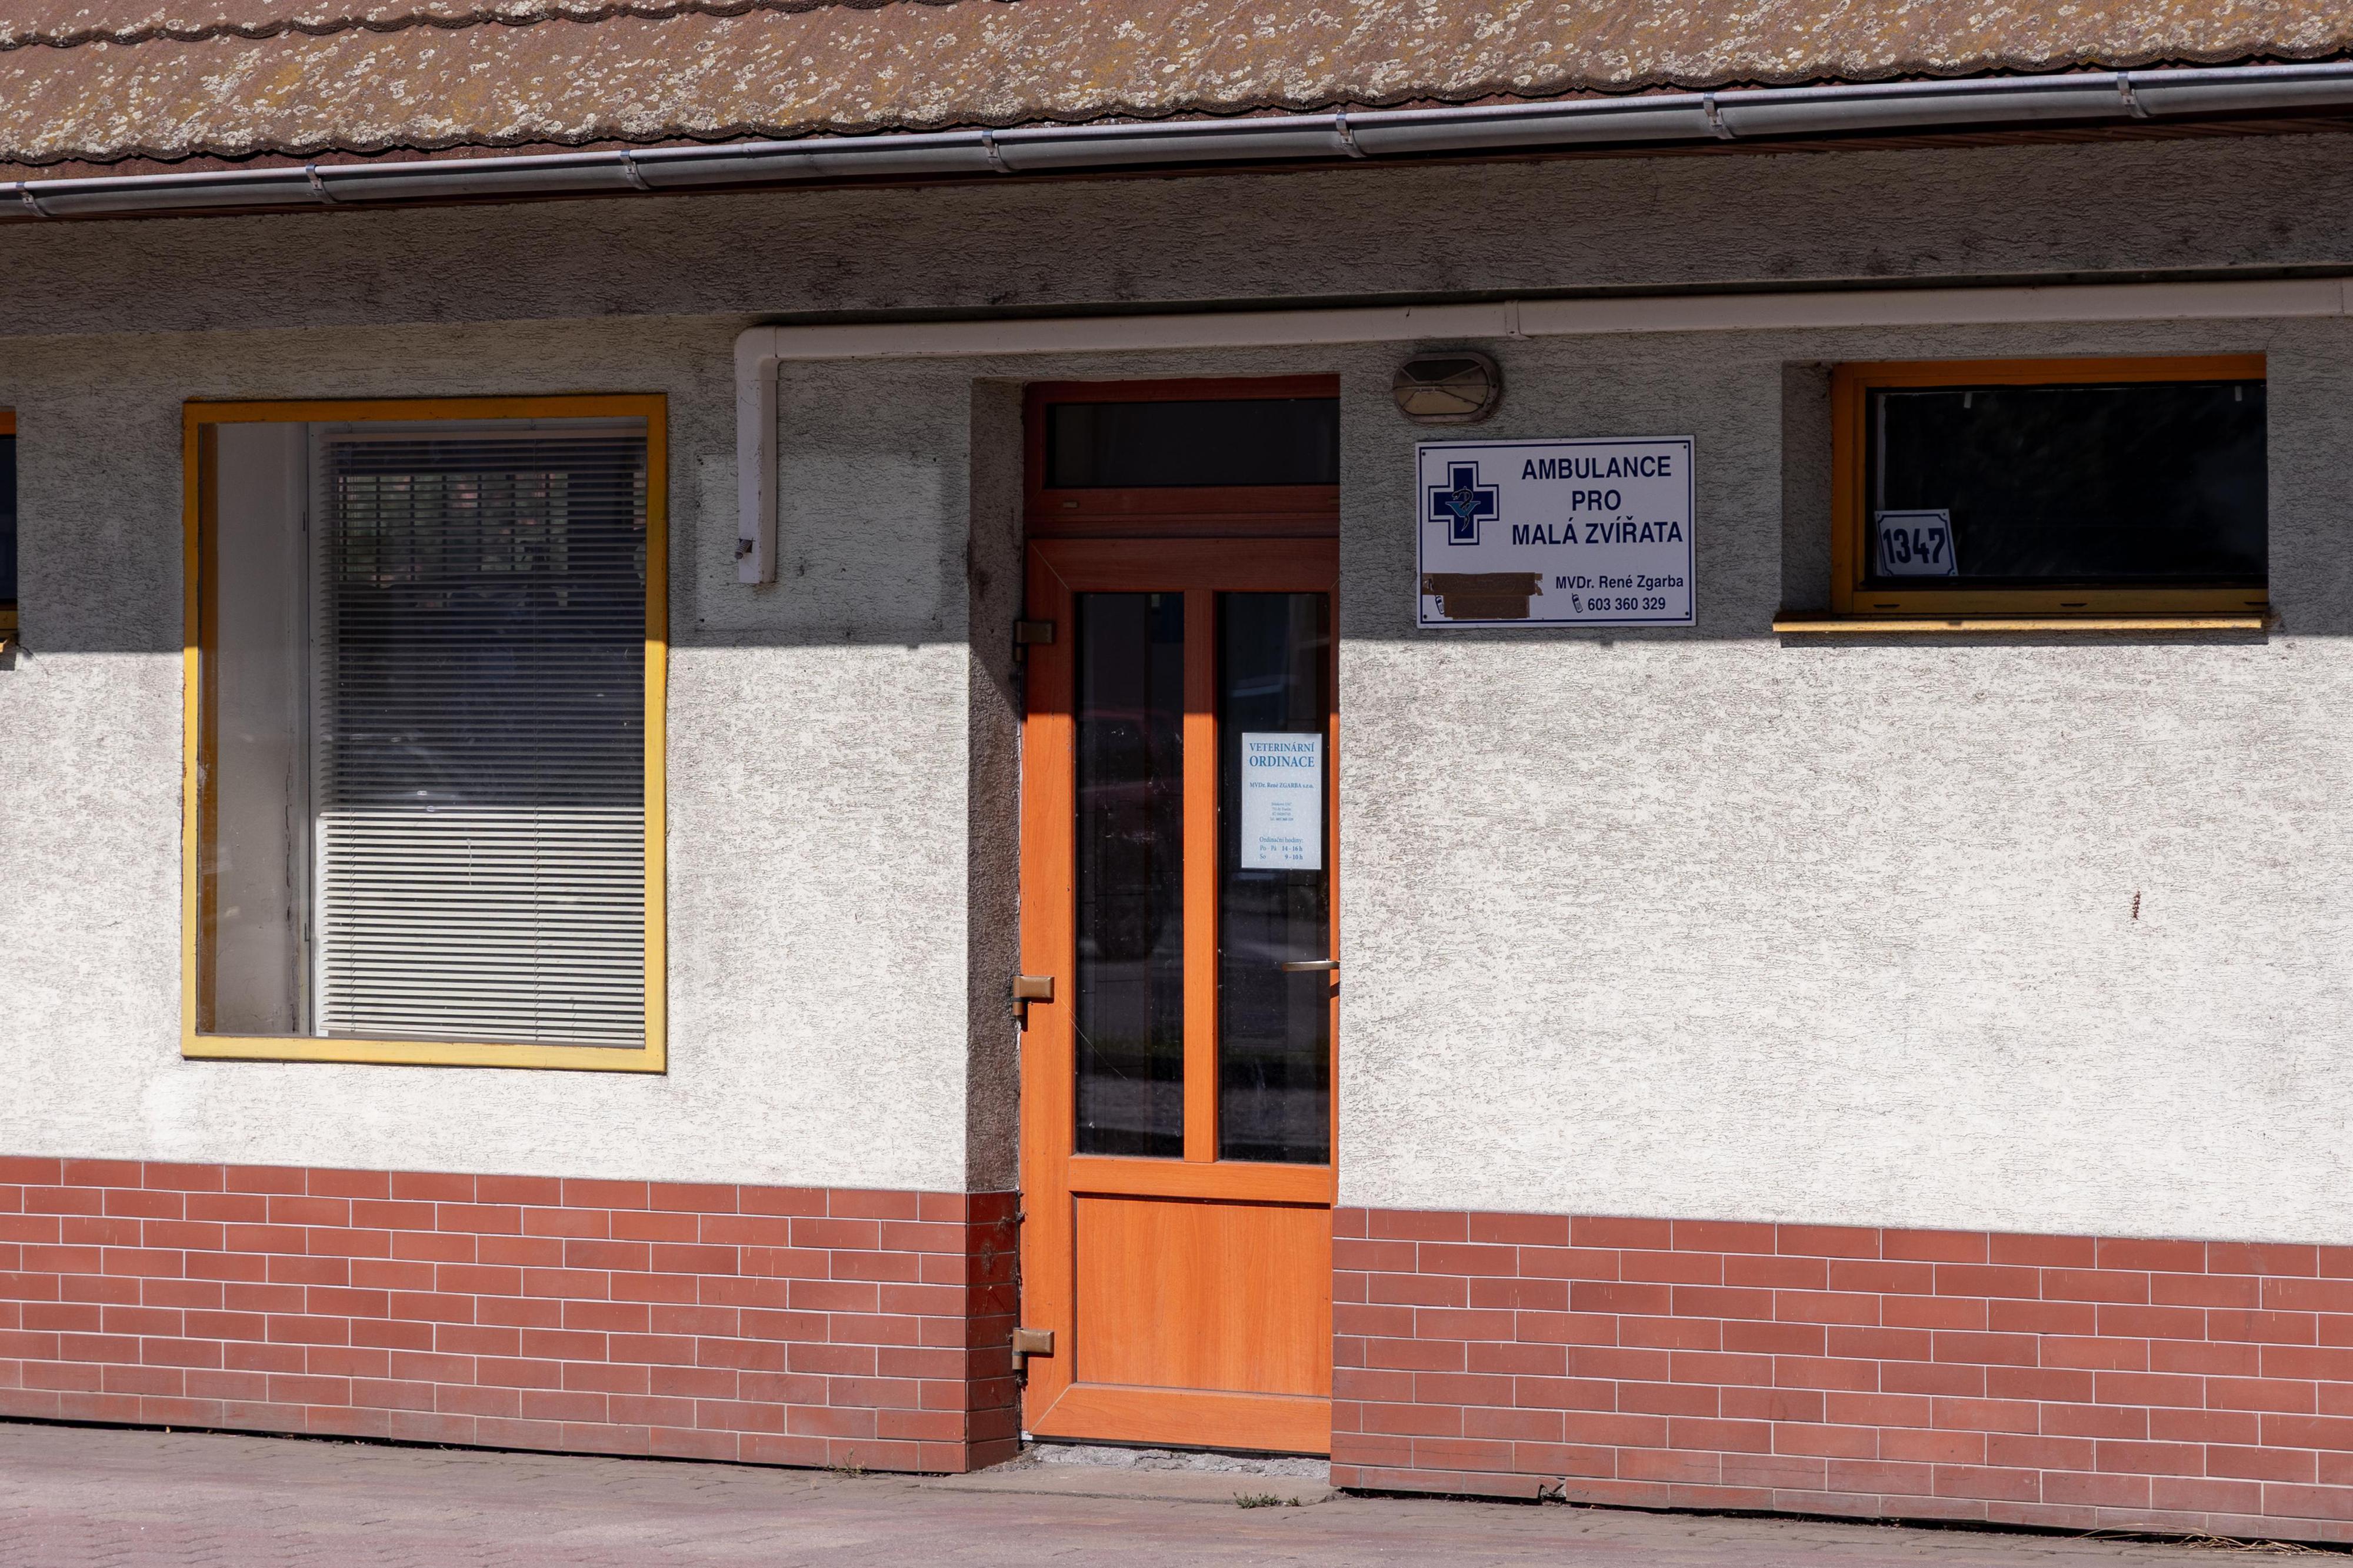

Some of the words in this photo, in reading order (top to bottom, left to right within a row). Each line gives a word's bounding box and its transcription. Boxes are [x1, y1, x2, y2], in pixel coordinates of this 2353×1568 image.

[1522, 456, 1672, 480] AMBULANCE
[1572, 489, 1621, 511] PRO
[1512, 517, 1578, 545] MALÁ
[1585, 516, 1683, 543] ZVÍŘATA
[1883, 528, 1945, 564] 1347
[1556, 576, 1594, 589] MVDr.
[1599, 575, 1632, 589] René
[1637, 575, 1684, 591] Zgarba
[1588, 598, 1613, 611] 603
[1615, 598, 1638, 610] 360
[1642, 597, 1666, 610] 329
[1249, 742, 1315, 752] VETERINÁRNÍ
[1249, 756, 1315, 768] ORDINACE
